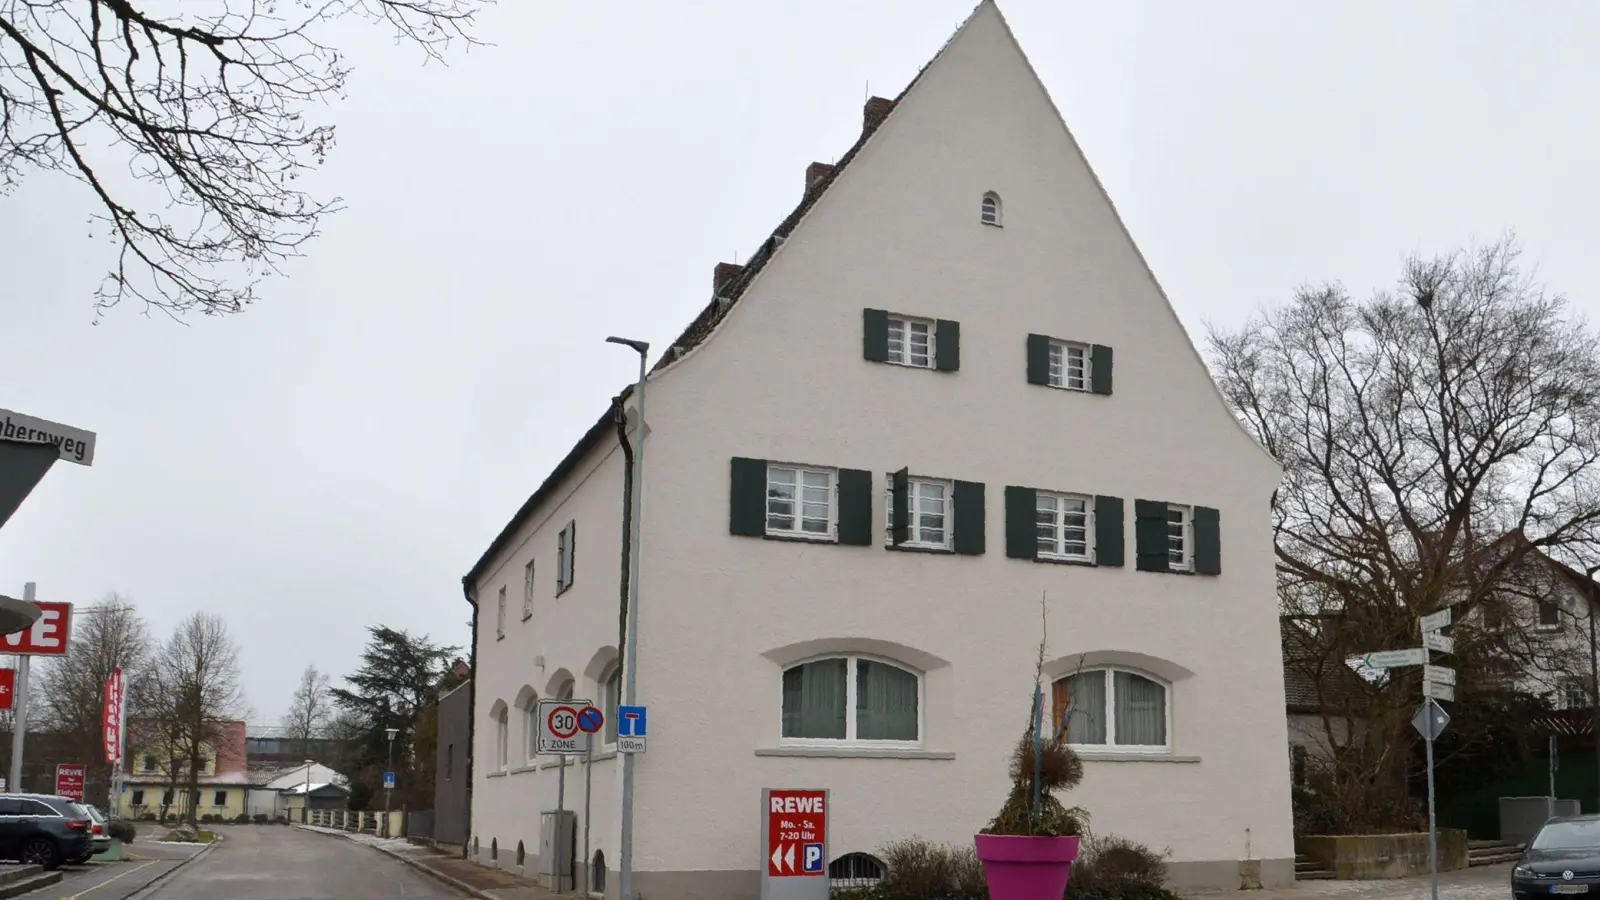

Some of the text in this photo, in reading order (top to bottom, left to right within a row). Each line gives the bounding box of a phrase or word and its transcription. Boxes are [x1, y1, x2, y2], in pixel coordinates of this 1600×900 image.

[0, 416, 86, 460] bergweg
[555, 715, 573, 730] 30
[551, 740, 576, 749] ZONE
[771, 797, 823, 813] REWE
[781, 820, 796, 828] Mo.
[803, 820, 815, 828] Sa.
[780, 831, 815, 840] 7-20 Uhr
[806, 847, 820, 869] P
